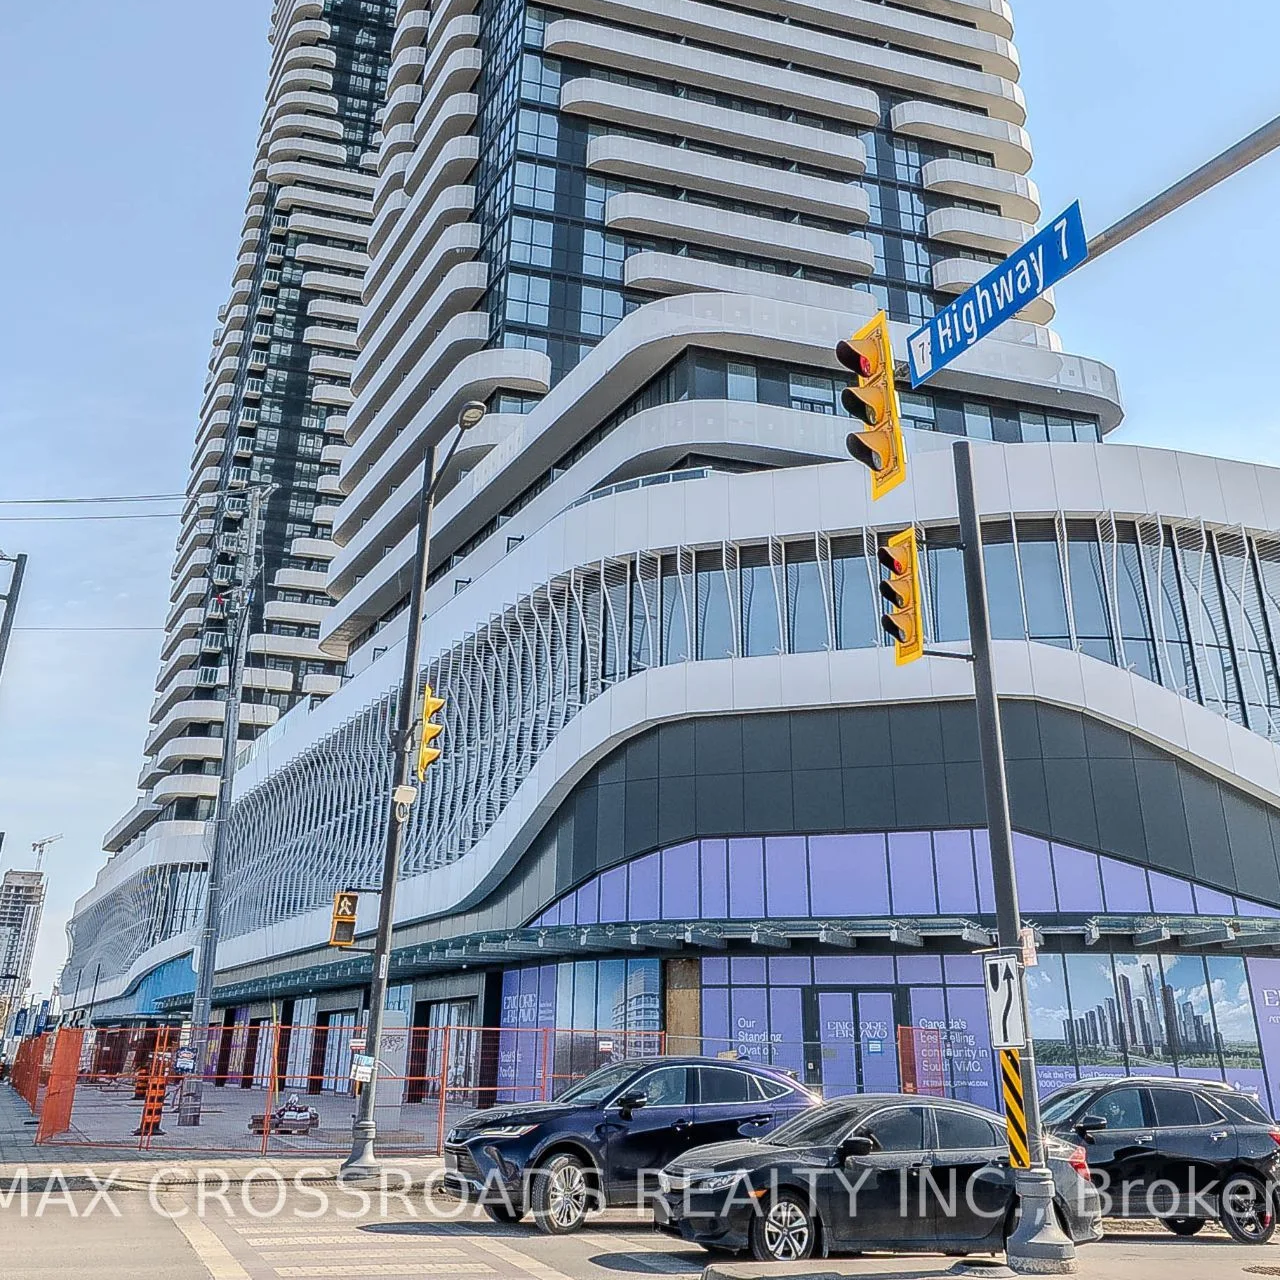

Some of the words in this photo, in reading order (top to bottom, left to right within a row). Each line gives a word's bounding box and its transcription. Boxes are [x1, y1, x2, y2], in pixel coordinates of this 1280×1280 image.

[936, 244, 1045, 355] Highway
[1054, 217, 1069, 261] 7
[737, 1017, 757, 1028] Our
[827, 1021, 888, 1030] ENCORE
[919, 1018, 968, 1030] Canada's
[737, 1030, 783, 1043] Standing
[835, 1029, 888, 1039] BRAVO
[978, 1046, 989, 1058] in
[922, 1059, 950, 1072] South
[1037, 1070, 1054, 1079] Visit
[1053, 1070, 1065, 1079] the
[1039, 1080, 1056, 1088] 1000
